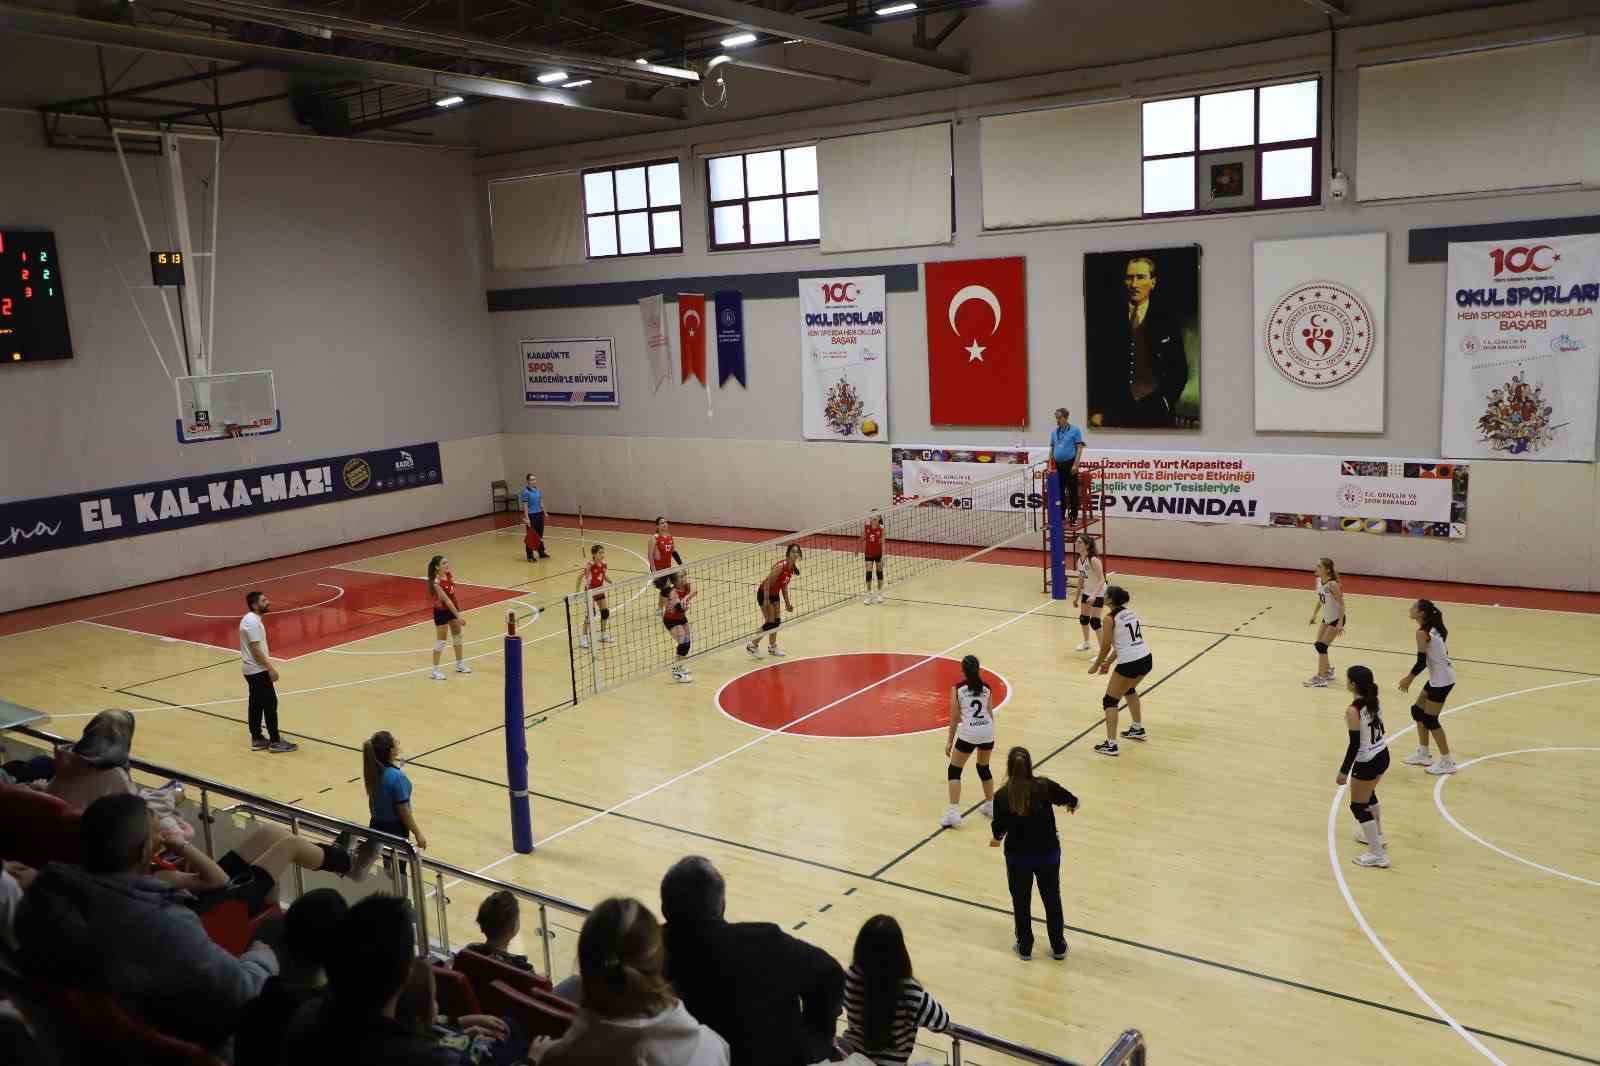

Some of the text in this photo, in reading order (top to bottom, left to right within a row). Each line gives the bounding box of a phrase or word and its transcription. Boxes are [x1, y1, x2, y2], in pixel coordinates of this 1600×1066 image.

[40, 252, 47, 261] 2
[22, 269, 50, 279] 2 2
[25, 287, 32, 297] 3
[1456, 283, 1600, 307] OKUL SPORLARI
[2, 298, 12, 315] 2
[805, 312, 883, 327] OKUL SPORLARI
[1458, 308, 1593, 321] HEM SPORDA HEM OKULDA
[1499, 320, 1547, 332] BAŞARI
[528, 362, 554, 373] SPOR
[1102, 456, 1151, 469] Üzerinde
[1153, 460, 1179, 469] Yurt
[1180, 460, 1242, 471] Kapasitesi
[1090, 470, 1255, 484] okunan Yüz Binlerce Etkinliği
[1144, 482, 1173, 493] Spor
[1173, 483, 1241, 494] Tesisleriyle
[80, 498, 122, 532] EL
[134, 466, 332, 523] KAL-KA-MAZ!
[1010, 492, 1043, 509] GS
[1121, 495, 1257, 517] YANINDA!
[1125, 620, 1143, 642] 14
[970, 699, 985, 719] 2
